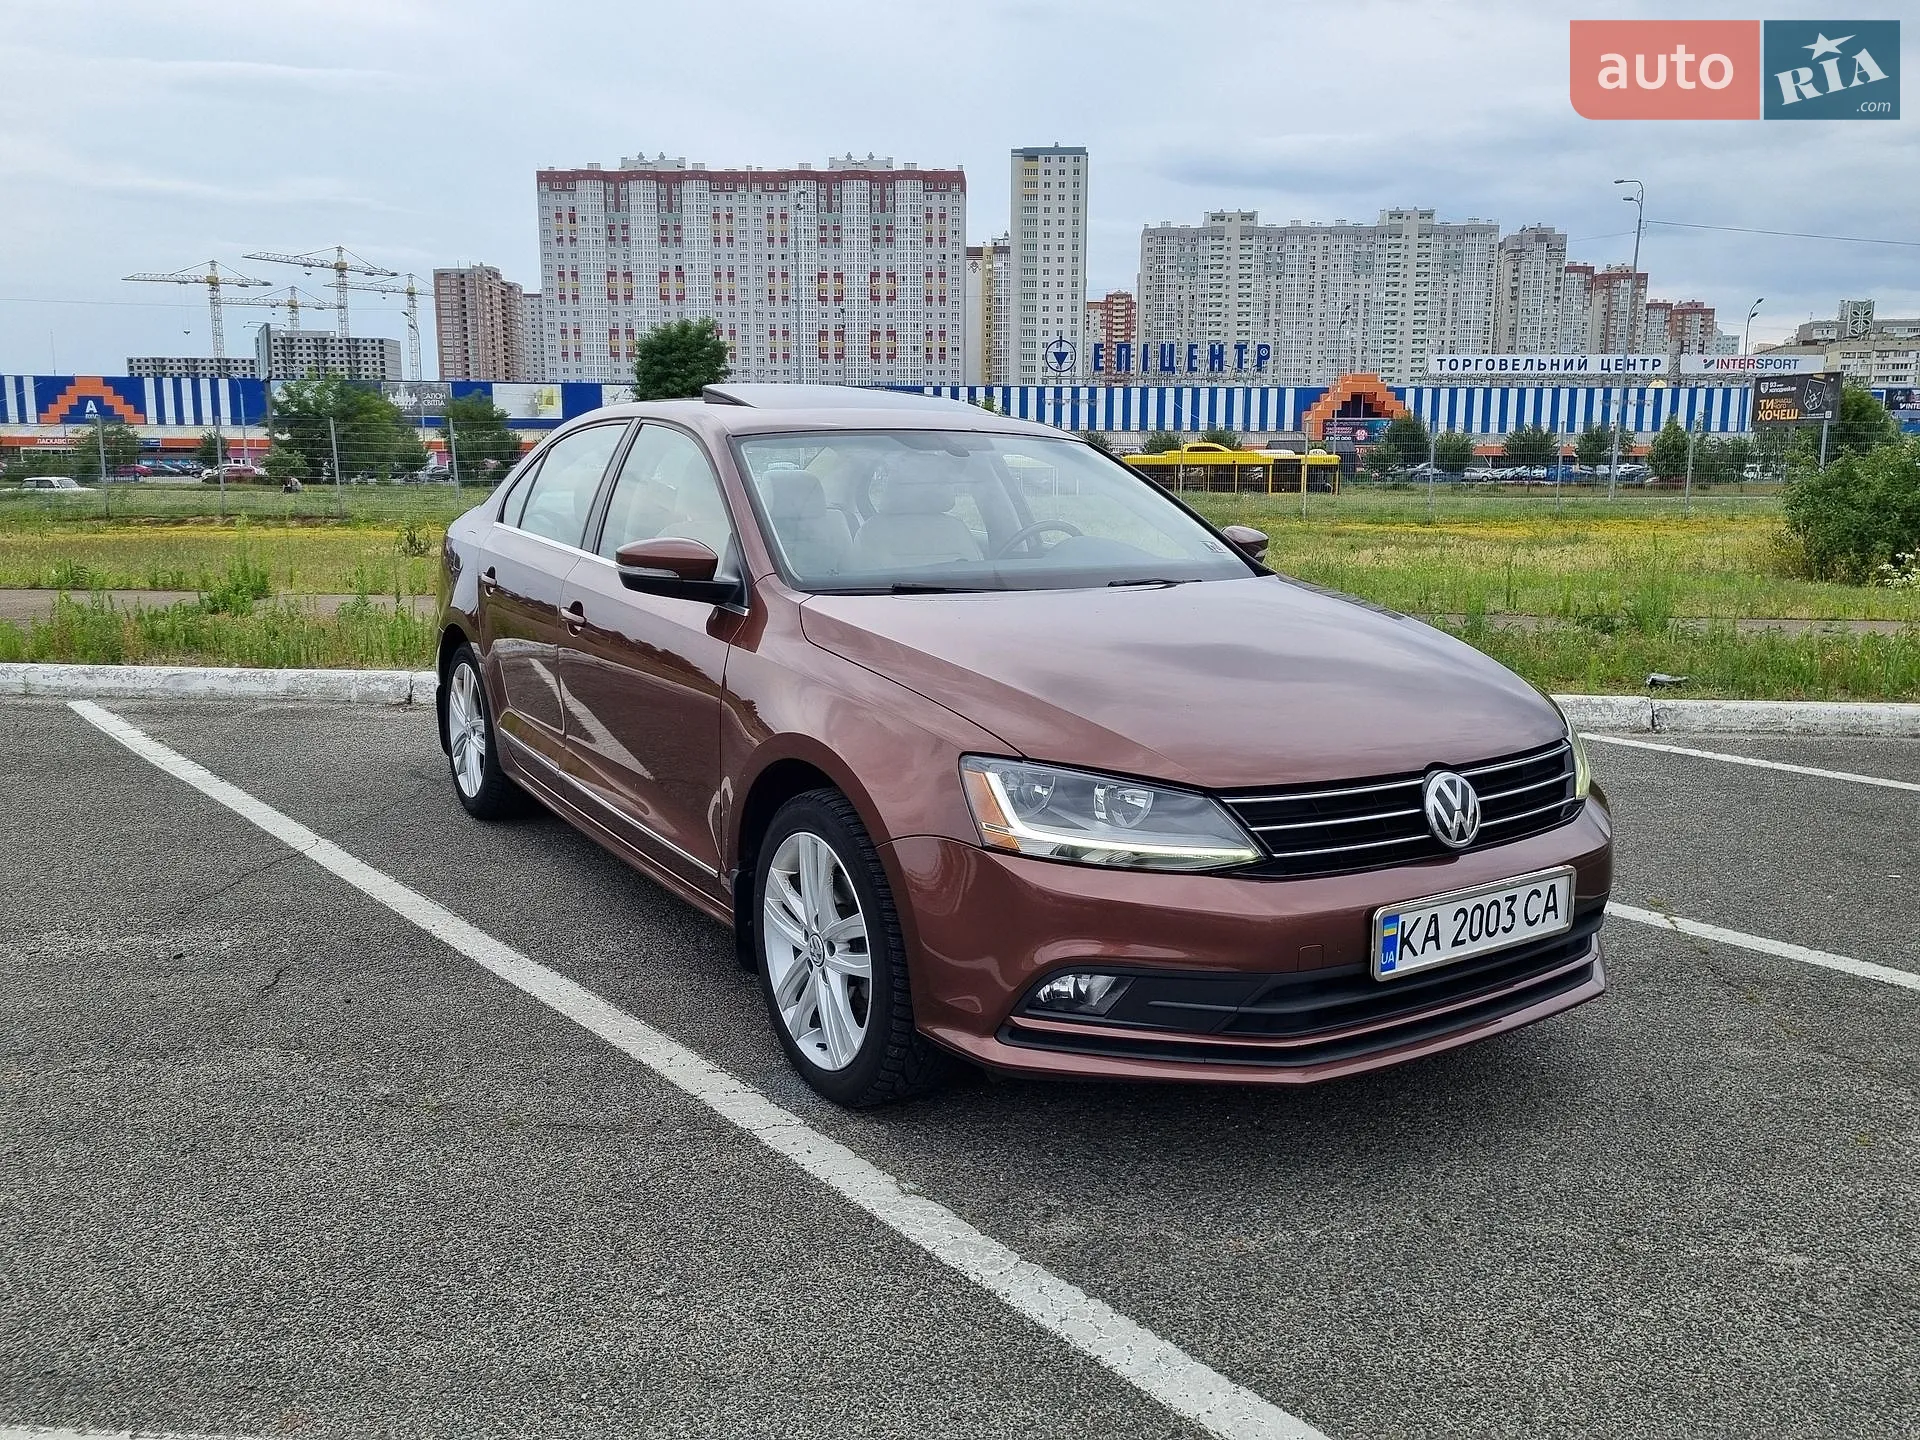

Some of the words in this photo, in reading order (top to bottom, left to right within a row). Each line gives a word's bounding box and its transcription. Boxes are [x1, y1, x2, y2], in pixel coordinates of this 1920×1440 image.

[1092, 343, 1272, 374] ЕПІЦЕНТР
[1436, 355, 1589, 373] ТОРГОВЕЛЬНИЙ
[1600, 358, 1663, 374] ЦЕНТР
[1715, 358, 1800, 371] INTERSPORT
[1759, 399, 1774, 410] ТИ
[1757, 409, 1799, 421] ХОЧЕШ
[1399, 913, 1441, 960] KA
[1451, 895, 1518, 947] 2003
[1523, 883, 1559, 926] CA
[1381, 952, 1395, 965] UA
